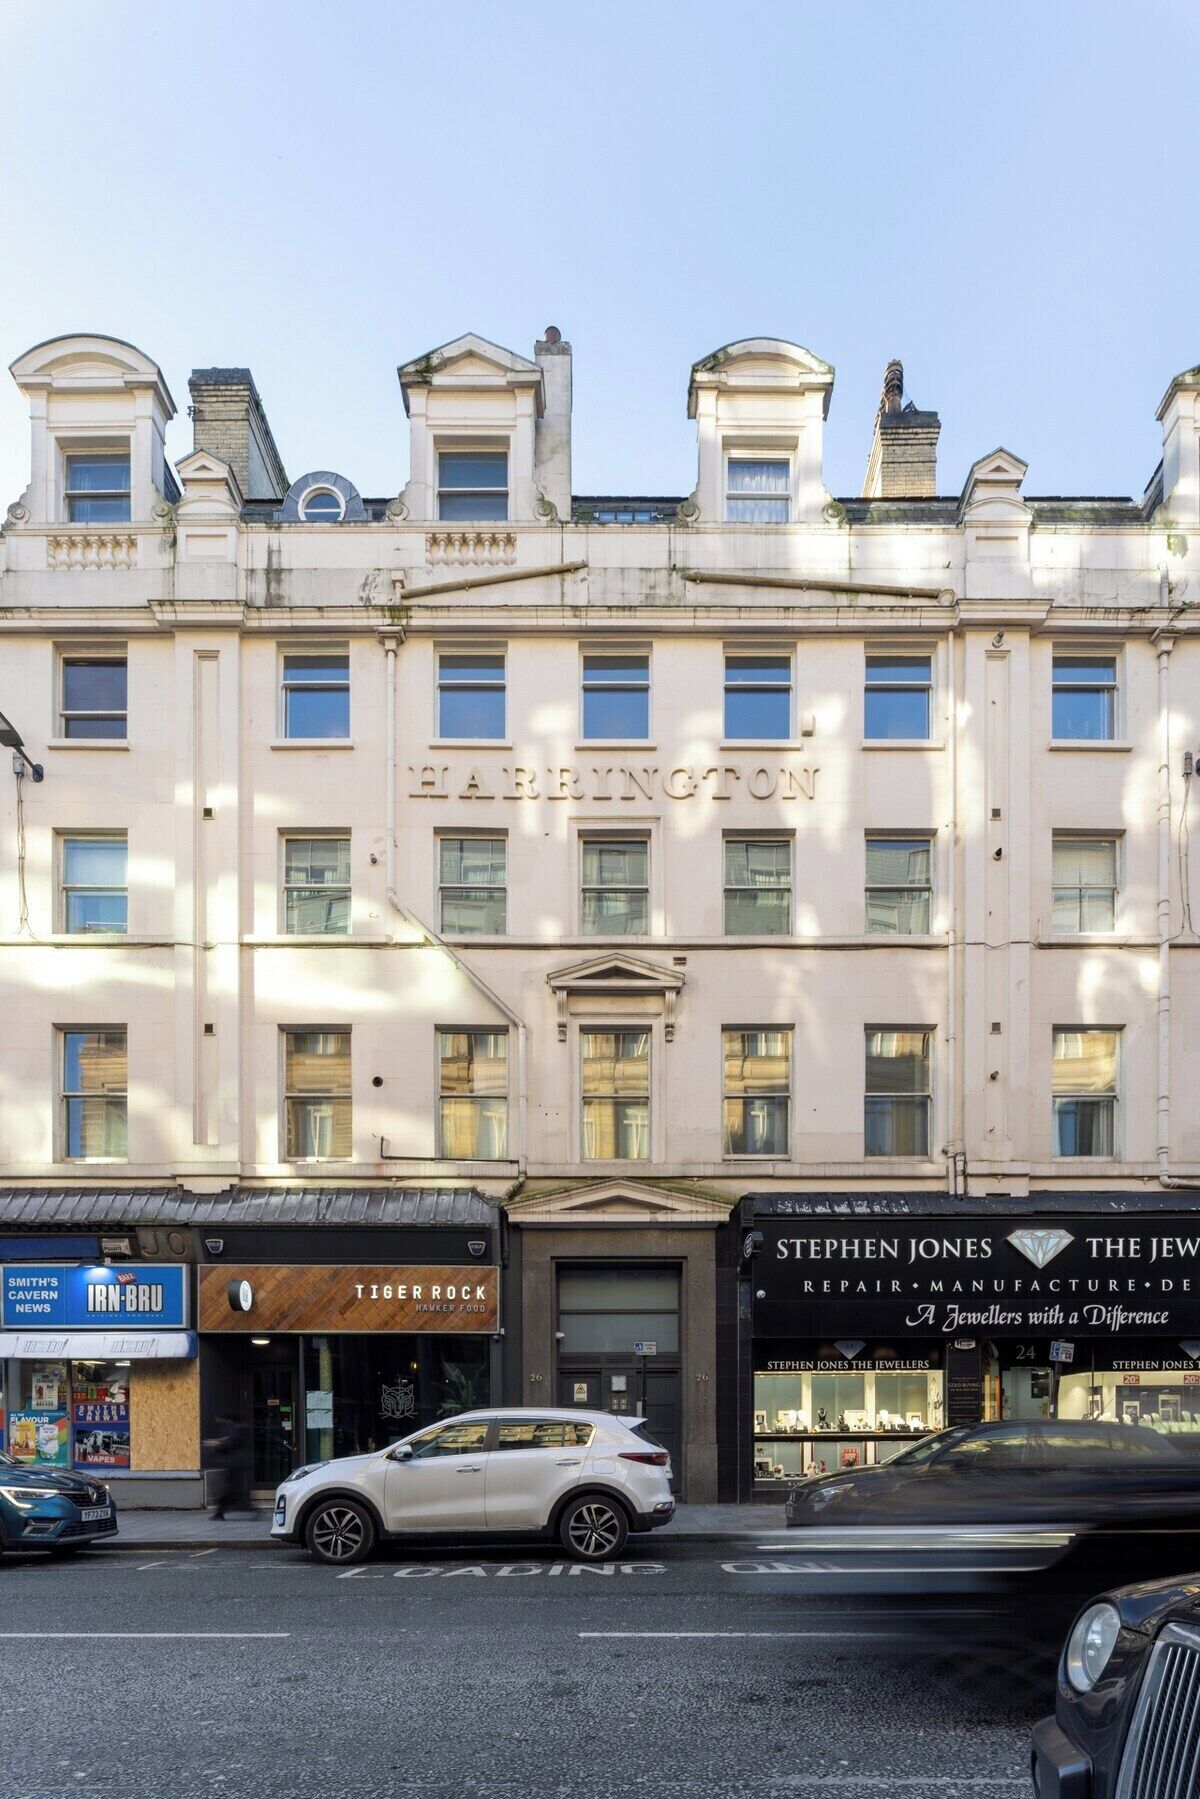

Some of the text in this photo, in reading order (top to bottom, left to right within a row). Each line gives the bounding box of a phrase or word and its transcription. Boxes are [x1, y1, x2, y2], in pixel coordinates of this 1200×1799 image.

[408, 765, 821, 800] HARRINGTON
[776, 1238, 900, 1260] STEPHEN
[908, 1238, 992, 1265] JONES
[1085, 1237, 1141, 1258] THE
[8, 1277, 59, 1287] SMITH'S
[803, 1280, 902, 1293] REPAIR
[930, 1279, 1136, 1293] MANUFACTURE
[8, 1290, 58, 1300] CAVERN
[87, 1283, 163, 1312] IRN-BRU
[355, 1285, 485, 1300] TIGER ROCK
[15, 1303, 51, 1313] NEWS
[416, 1304, 485, 1313] HAWKER FOOD
[905, 1304, 1169, 1332] A Jewellers with a Difference
[1016, 1345, 1036, 1360] 24
[767, 1361, 930, 1371] STEPHEN JONES THE JEWELLERS
[1112, 1361, 1159, 1370] STEPHEN
[1162, 1361, 1194, 1371] JONES
[529, 1373, 543, 1382] 26
[696, 1372, 709, 1381] 26
[10, 1416, 49, 1424] FLAVOUR
[87, 1455, 116, 1463] VAPES
[335, 1563, 668, 1579] LOADING
